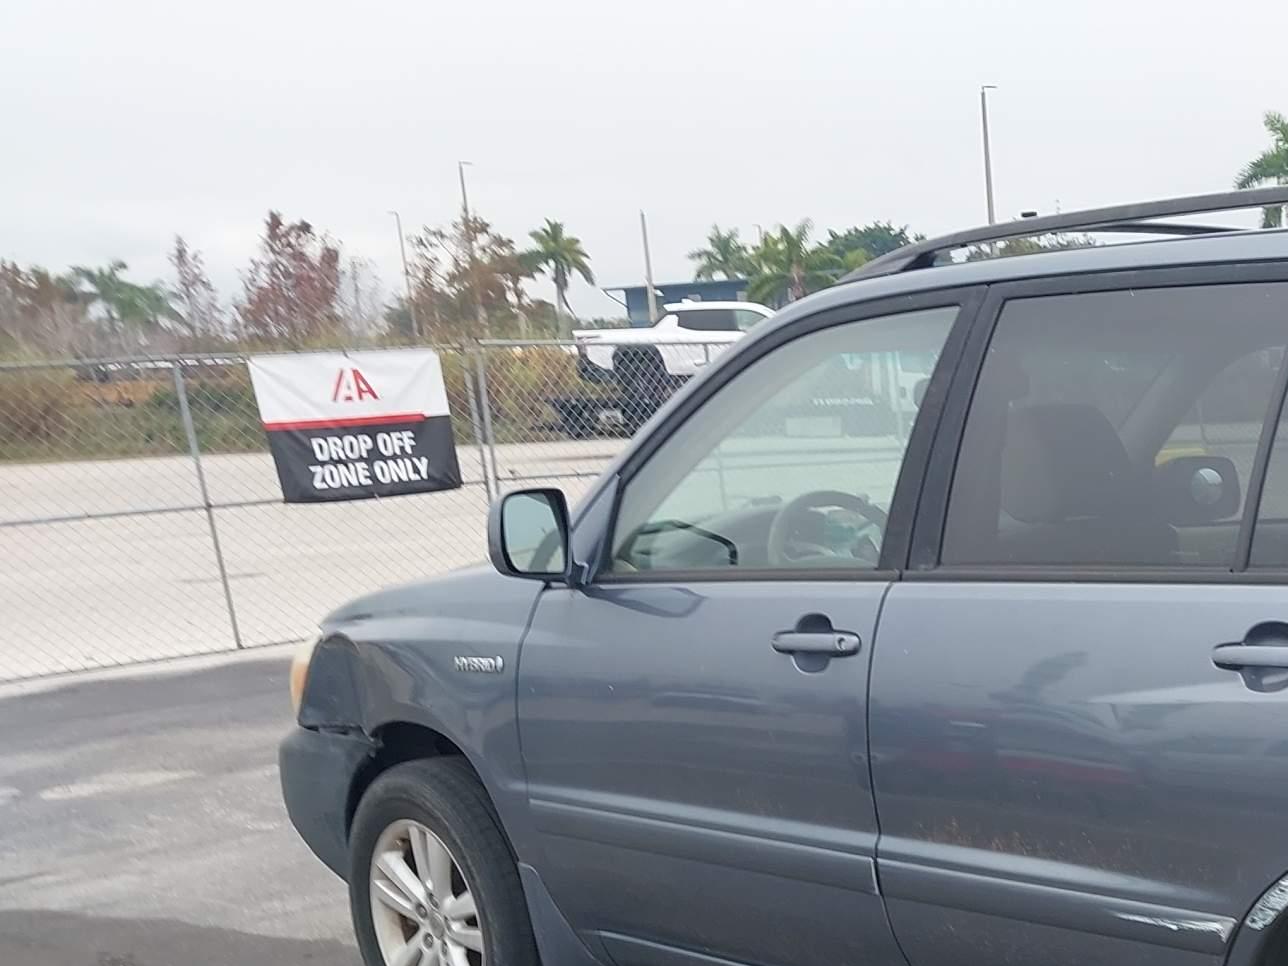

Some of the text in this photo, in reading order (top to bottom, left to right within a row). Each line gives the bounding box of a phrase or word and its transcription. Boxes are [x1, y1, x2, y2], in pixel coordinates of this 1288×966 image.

[310, 430, 417, 461] DROP OFF
[308, 456, 429, 490] ZONE ONLY
